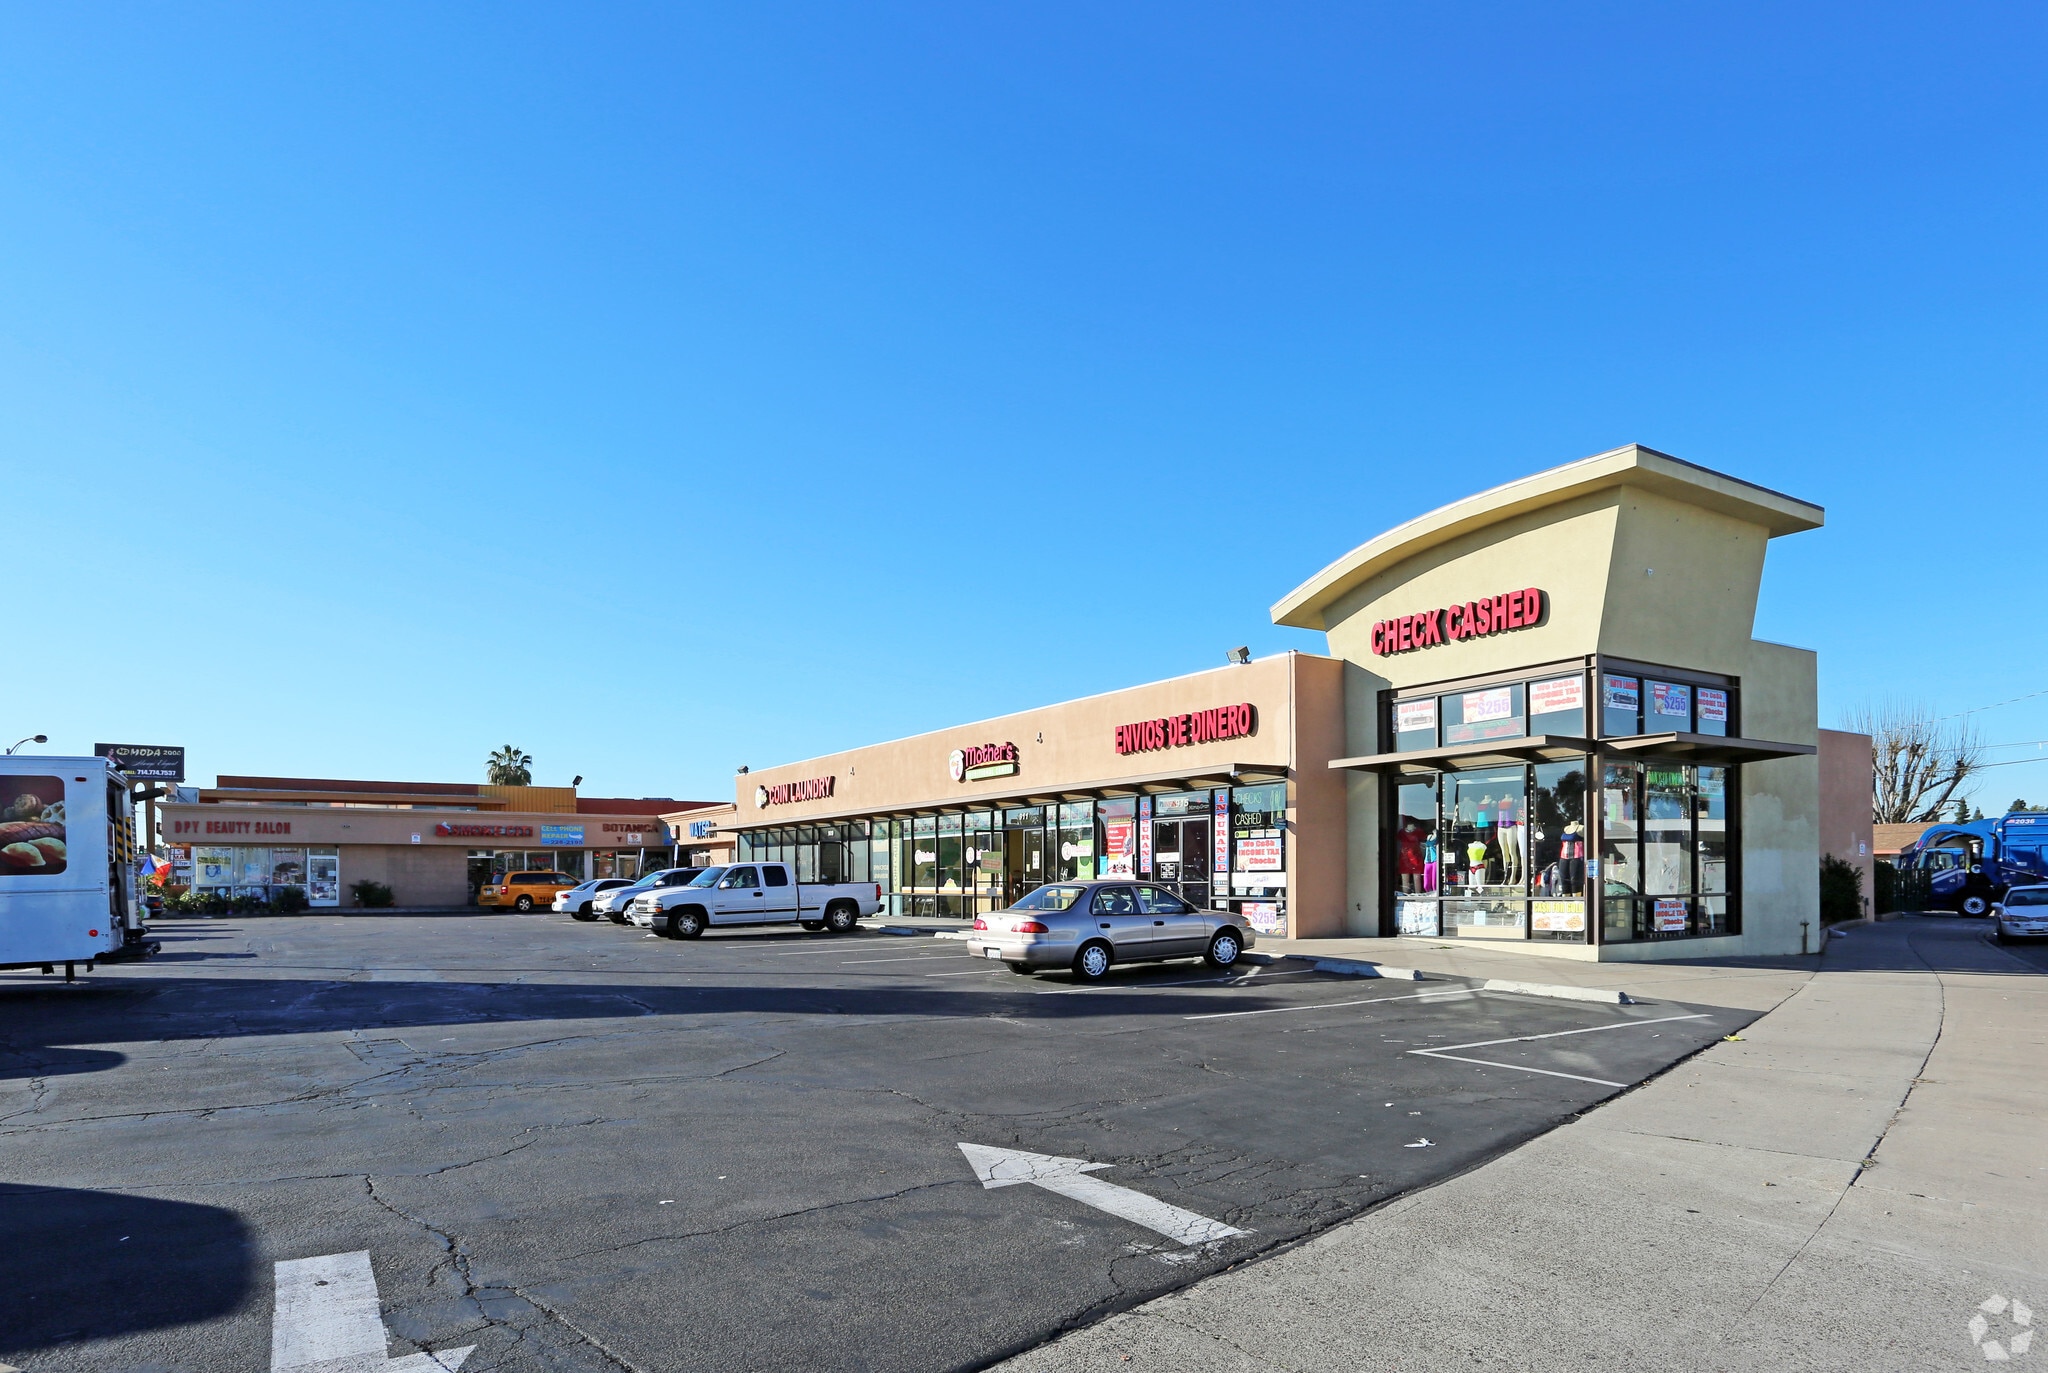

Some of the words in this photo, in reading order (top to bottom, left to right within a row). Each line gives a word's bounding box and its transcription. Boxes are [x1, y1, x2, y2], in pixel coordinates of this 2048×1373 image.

[1371, 608, 1442, 656] CHECK
[1446, 587, 1542, 640] CASHED
[1477, 698, 1509, 716] $255
[1664, 696, 1686, 711] $255
[1115, 718, 1165, 754] ENVIOS
[1168, 714, 1188, 745] DE
[1191, 703, 1250, 742] DINERO
[130, 748, 161, 756] MODA
[769, 783, 789, 804] COIN
[791, 776, 831, 801] LAUNDRY
[1235, 792, 1262, 806] CHECKS
[1234, 812, 1262, 826] CASHED
[175, 821, 199, 834] DPY
[206, 821, 251, 834] BEAUTY
[255, 822, 290, 834] SALON
[451, 826, 503, 837] SMOKE
[506, 826, 533, 837] CITI
[602, 823, 659, 833] BOTANICA
[1215, 795, 1227, 871] INSURANCE
[1141, 801, 1151, 872] INSURANCE
[1238, 848, 1265, 856] INCOME
[1267, 848, 1280, 856] TAX
[1534, 902, 1551, 913] CASH
[1552, 902, 1564, 913] FOR
[1567, 902, 1584, 913] GOLD
[1252, 911, 1276, 924] $255
